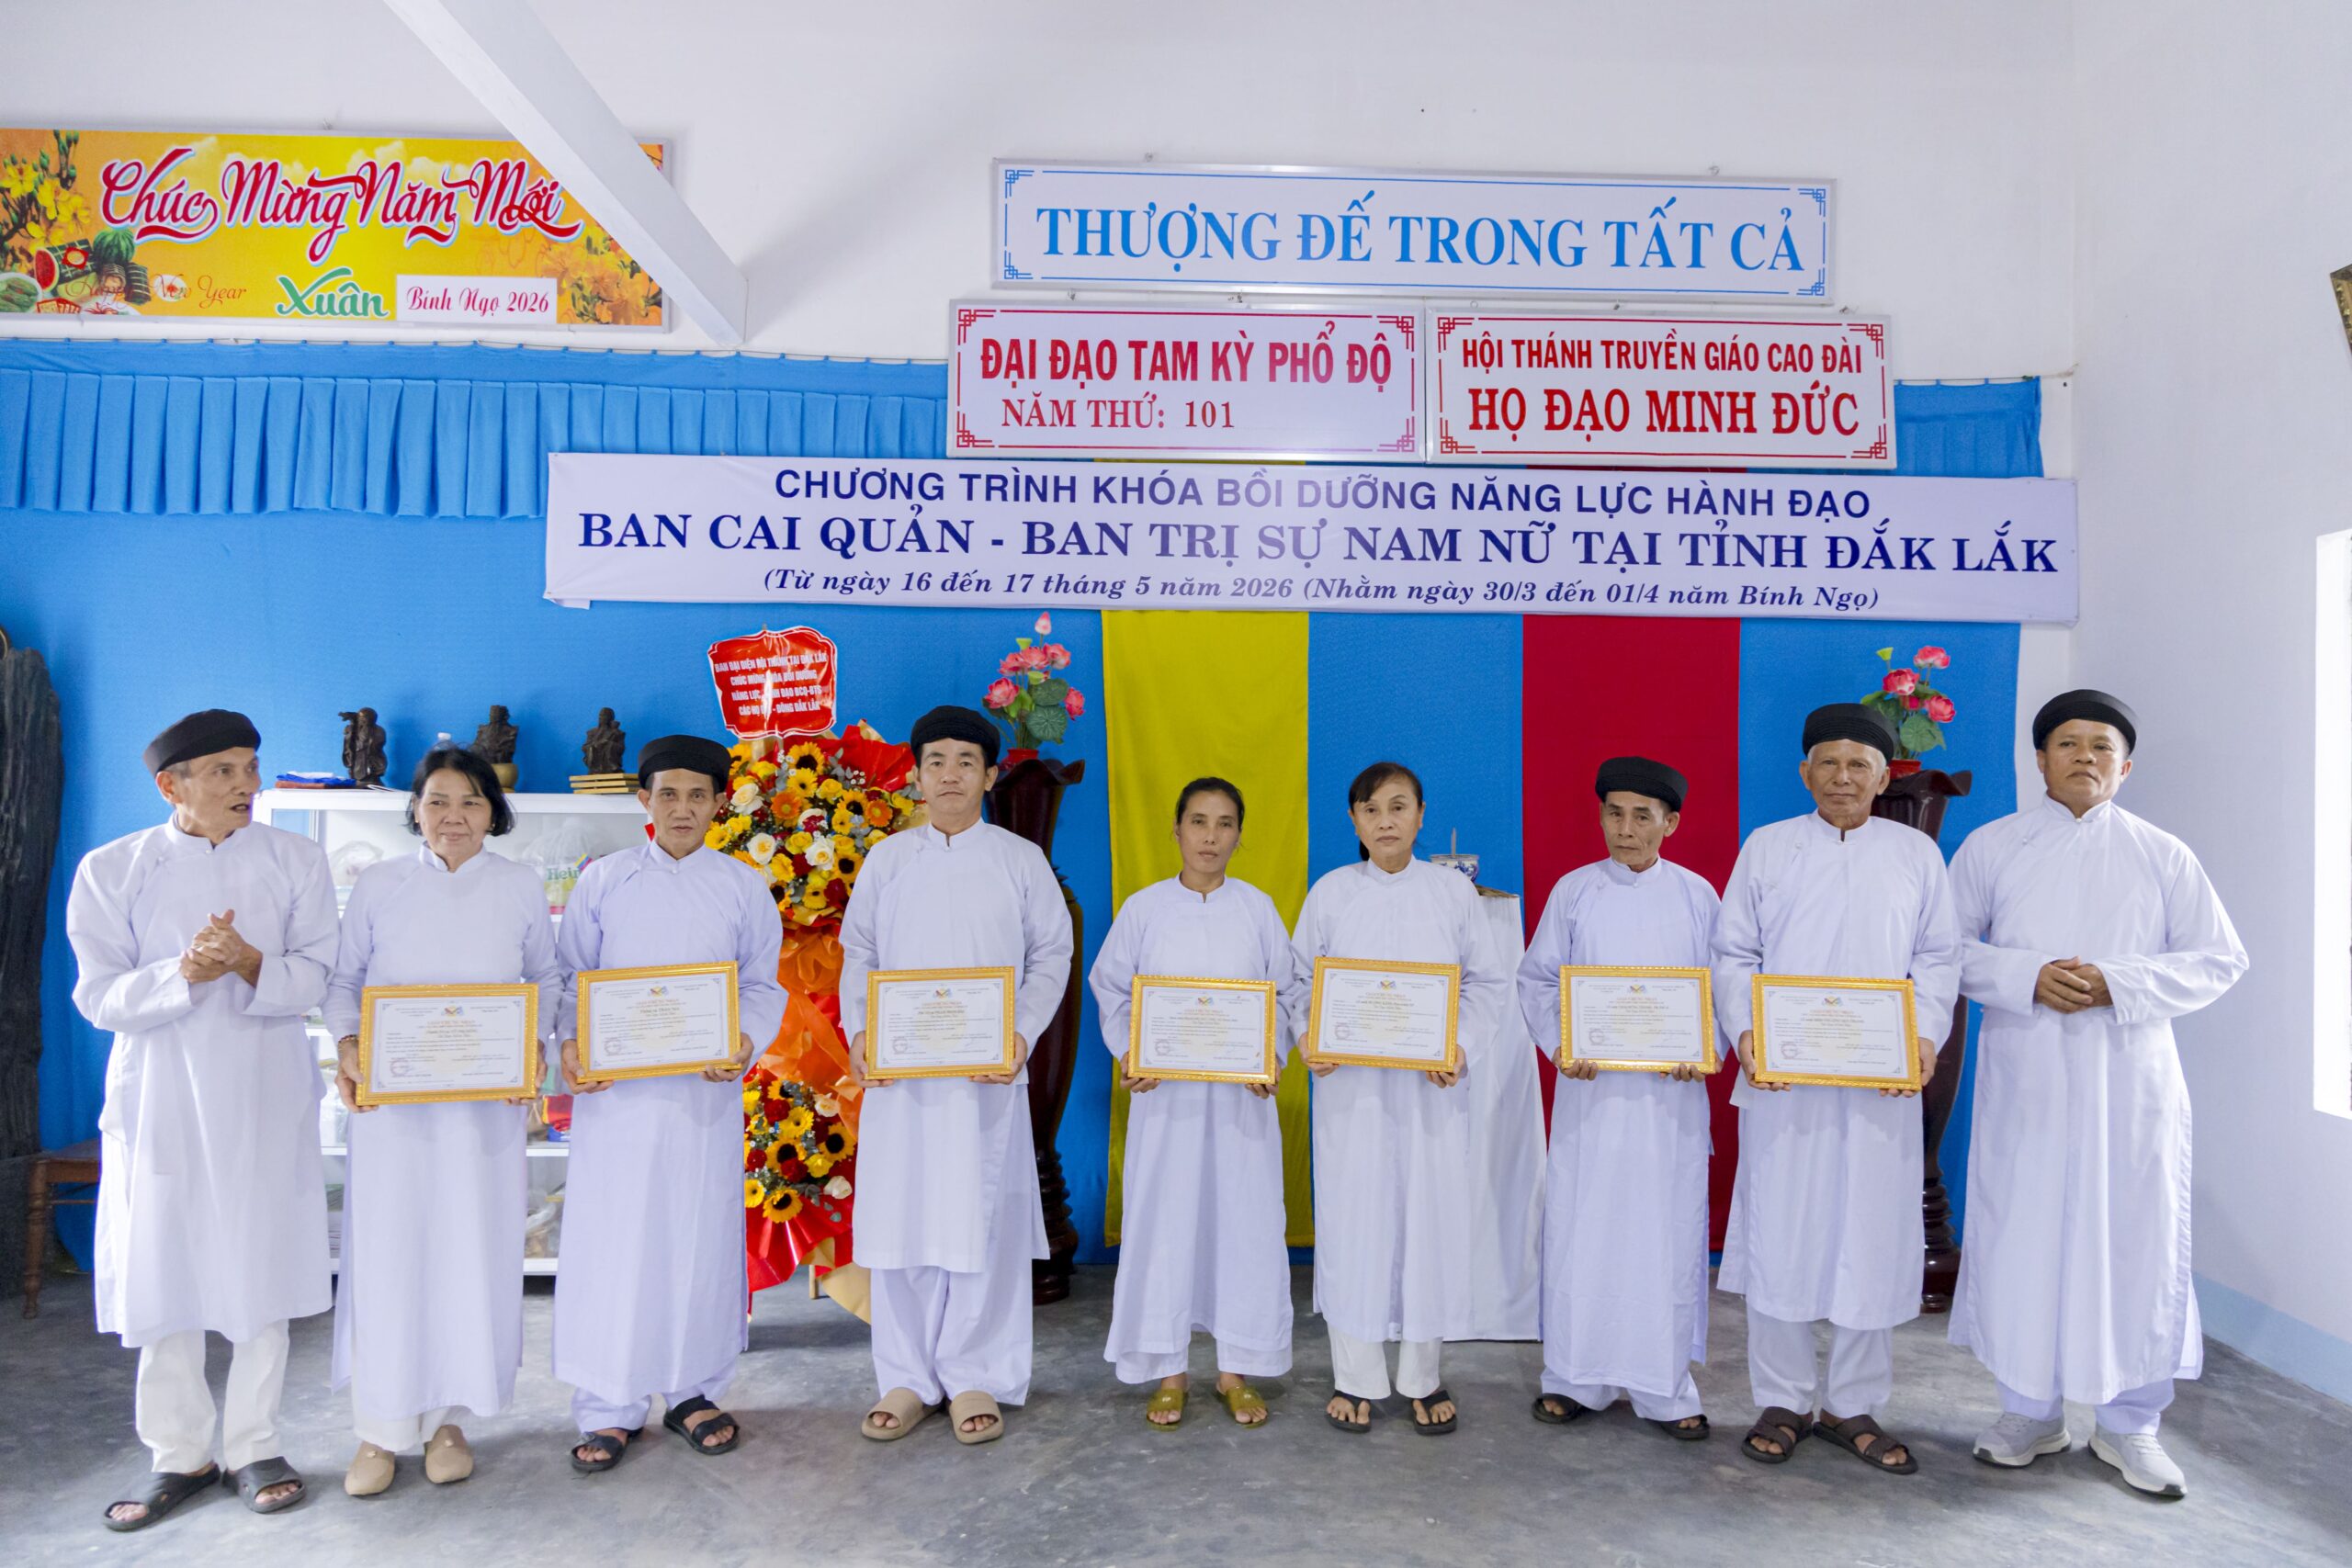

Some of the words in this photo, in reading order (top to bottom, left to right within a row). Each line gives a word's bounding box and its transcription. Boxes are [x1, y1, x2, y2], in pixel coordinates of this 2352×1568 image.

[101, 148, 219, 241] Chúc
[221, 159, 364, 263] Mừng
[354, 160, 458, 244] Năm
[441, 160, 582, 238] Mới
[1036, 202, 1282, 272] THƯỢNG
[1296, 190, 1374, 262] ĐẾ
[1389, 216, 1588, 267] TRONG
[1604, 197, 1713, 268] TẤT
[1731, 208, 1804, 271] CẢ
[198, 275, 247, 310] Year
[277, 267, 389, 317] Xuân
[406, 286, 452, 310] Bính
[459, 287, 499, 317] Ngọ
[506, 291, 549, 312] 2026
[980, 338, 1037, 389] ĐẠI
[1048, 339, 1117, 389] ĐẠO
[1128, 340, 1198, 381] TAM
[1212, 330, 1254, 381] KỲ
[1269, 321, 1335, 383] PHỔ
[1346, 333, 1391, 392] ĐỘ
[1463, 331, 1503, 374] HỘI
[1511, 331, 1592, 368] THÁNH
[1600, 328, 1696, 370] TRUYỀN
[1704, 334, 1759, 372] GIÁO
[1768, 343, 1814, 373] CAO
[1821, 336, 1861, 373] ĐÀI
[1001, 391, 1078, 428] NĂM
[1087, 391, 1164, 428] THỨ:
[1185, 400, 1235, 428] 101
[1468, 388, 1526, 442] HỌ
[1544, 389, 1630, 443] ĐẠO
[1645, 390, 1758, 434] MINH
[1772, 379, 1860, 436] ĐỨC
[775, 468, 944, 501] CHƯƠNG
[959, 467, 1076, 503] TRÌNH
[1093, 469, 1203, 505] KHÓA
[1217, 468, 1282, 507] BỒI
[1298, 477, 1435, 510] DƯỠNG
[1452, 476, 1561, 513] NĂNG
[1577, 482, 1653, 519] LỰC
[1668, 479, 1773, 516] HÀNH
[1788, 490, 1870, 523] ĐẠO
[578, 513, 692, 548] BAN
[709, 514, 801, 550] CAI
[820, 503, 975, 559] QUẢN
[1022, 521, 1133, 557] BAN
[1148, 524, 1239, 567] TRỊ
[1258, 518, 1328, 569] SỰ
[1343, 527, 1462, 561] NAM
[1478, 520, 1556, 564] NỮ
[1572, 531, 1661, 573] TẠI
[1679, 519, 1808, 568] TỈNH
[1825, 518, 1937, 570] ĐẮK
[1951, 520, 2058, 572] LẮK
[764, 569, 815, 592] (Từ
[822, 570, 890, 595] ngày
[901, 572, 933, 591] 16
[941, 570, 992, 592] đến
[1003, 574, 1035, 592] 17
[1043, 573, 1126, 599] tháng
[1136, 576, 1151, 594] 5
[1160, 577, 1221, 596] năm
[1230, 578, 1294, 597] 2026
[1304, 575, 1397, 600] (Nhằm
[1408, 581, 1474, 604] ngày
[1484, 581, 1536, 601] 30/3
[1546, 580, 1596, 602] đến
[1607, 583, 1658, 603] 01/4
[1669, 585, 1728, 604] năm
[1737, 585, 1804, 605] Bính
[1814, 587, 1878, 611] Ngọ)
